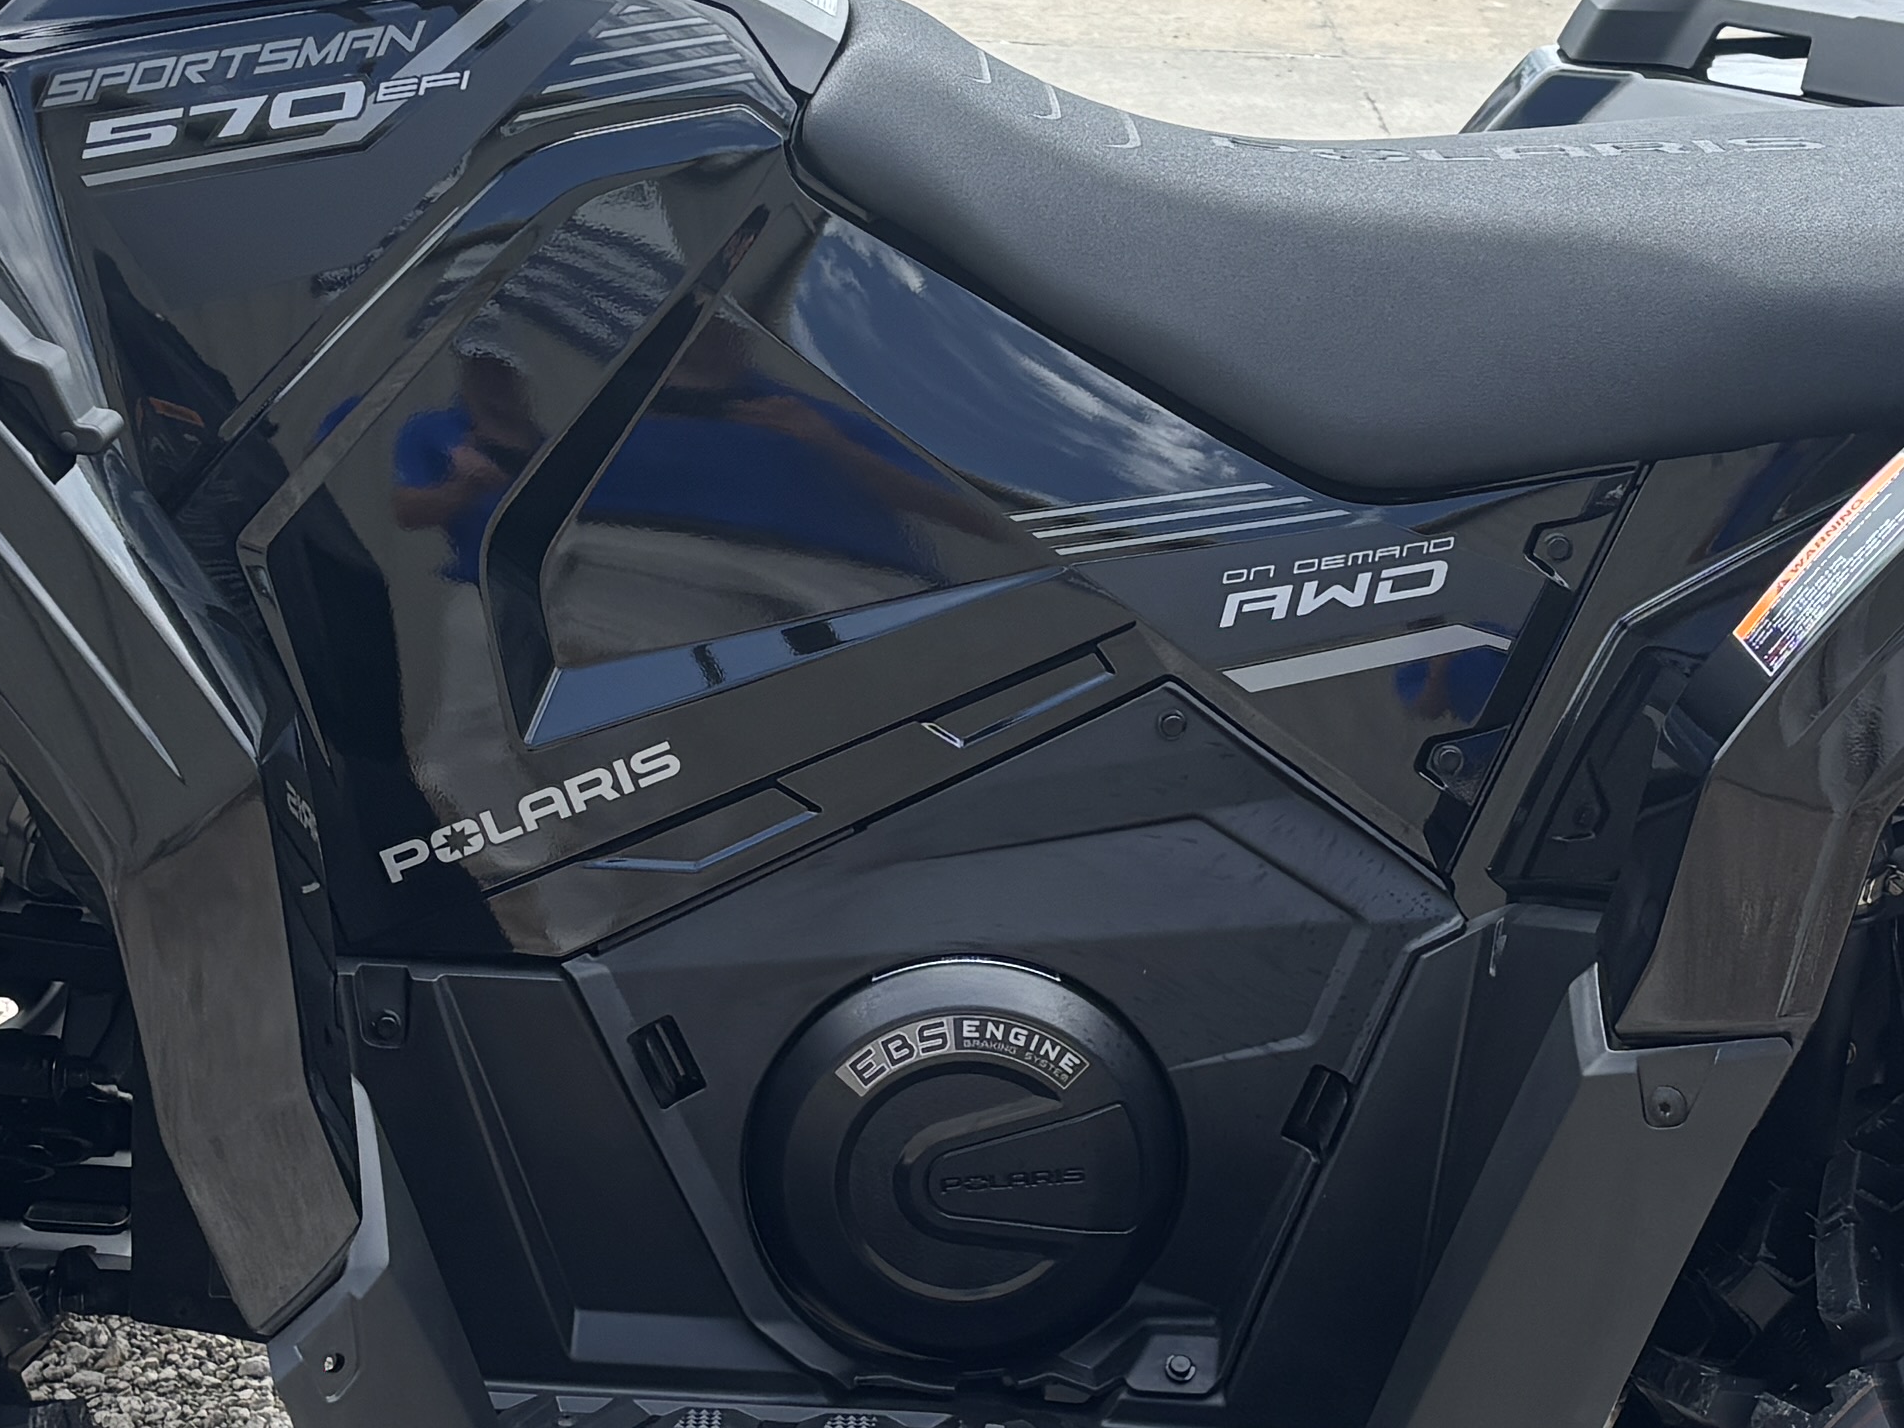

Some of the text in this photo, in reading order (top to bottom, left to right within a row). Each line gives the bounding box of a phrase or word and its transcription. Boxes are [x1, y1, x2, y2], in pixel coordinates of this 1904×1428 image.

[41, 20, 426, 108] SPORTSMAN
[82, 70, 471, 160] 570 EFI
[1210, 134, 1827, 163] POLARIS
[1221, 536, 1455, 585] ON DEMAND
[1789, 498, 1865, 574] WARNING
[1218, 559, 1449, 629] AWD
[378, 740, 682, 884] POLARIS
[846, 1018, 1082, 1090] EBS ENGINE
[963, 1038, 1019, 1056] BRAKING
[940, 1167, 1086, 1195] POLARIS
